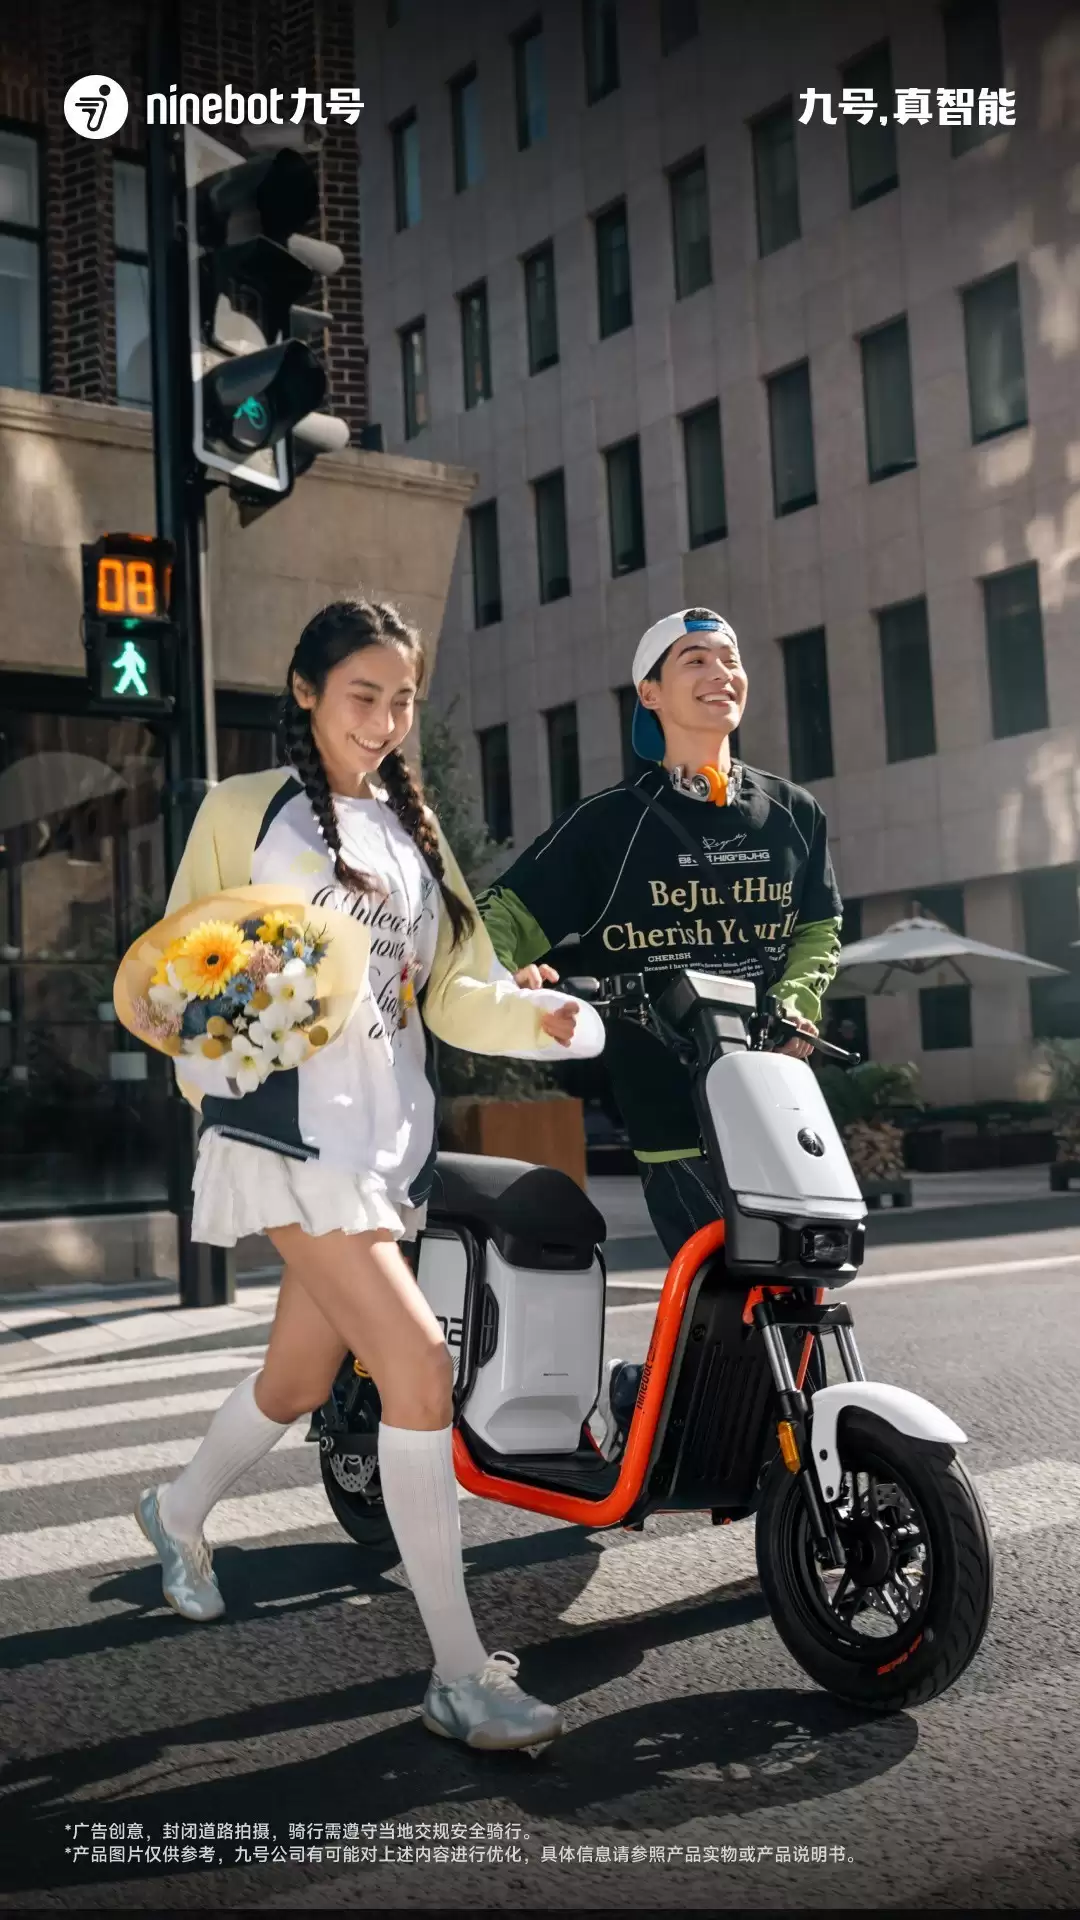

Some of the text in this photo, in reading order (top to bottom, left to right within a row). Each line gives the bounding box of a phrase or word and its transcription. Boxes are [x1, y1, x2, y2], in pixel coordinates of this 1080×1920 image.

[97, 558, 156, 615] 08
[648, 876, 793, 913] BeJutHug
[602, 917, 715, 951] Cherish
[647, 952, 692, 962] CHERISH
